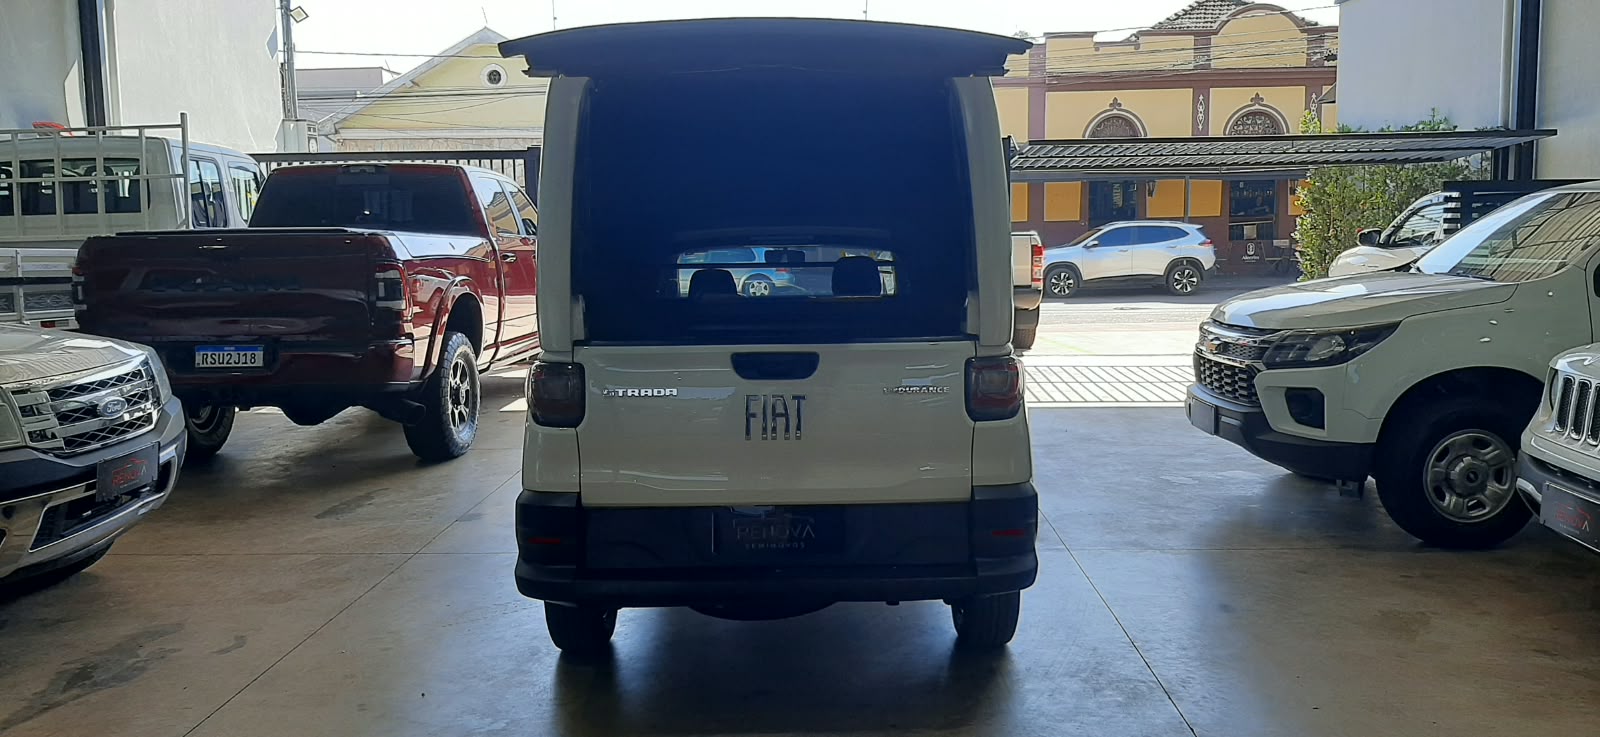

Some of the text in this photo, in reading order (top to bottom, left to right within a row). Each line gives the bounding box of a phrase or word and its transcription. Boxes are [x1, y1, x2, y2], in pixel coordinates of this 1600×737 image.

[201, 352, 257, 365] RSU2J18
[106, 401, 121, 412] Ford
[744, 394, 806, 441] FIAT
